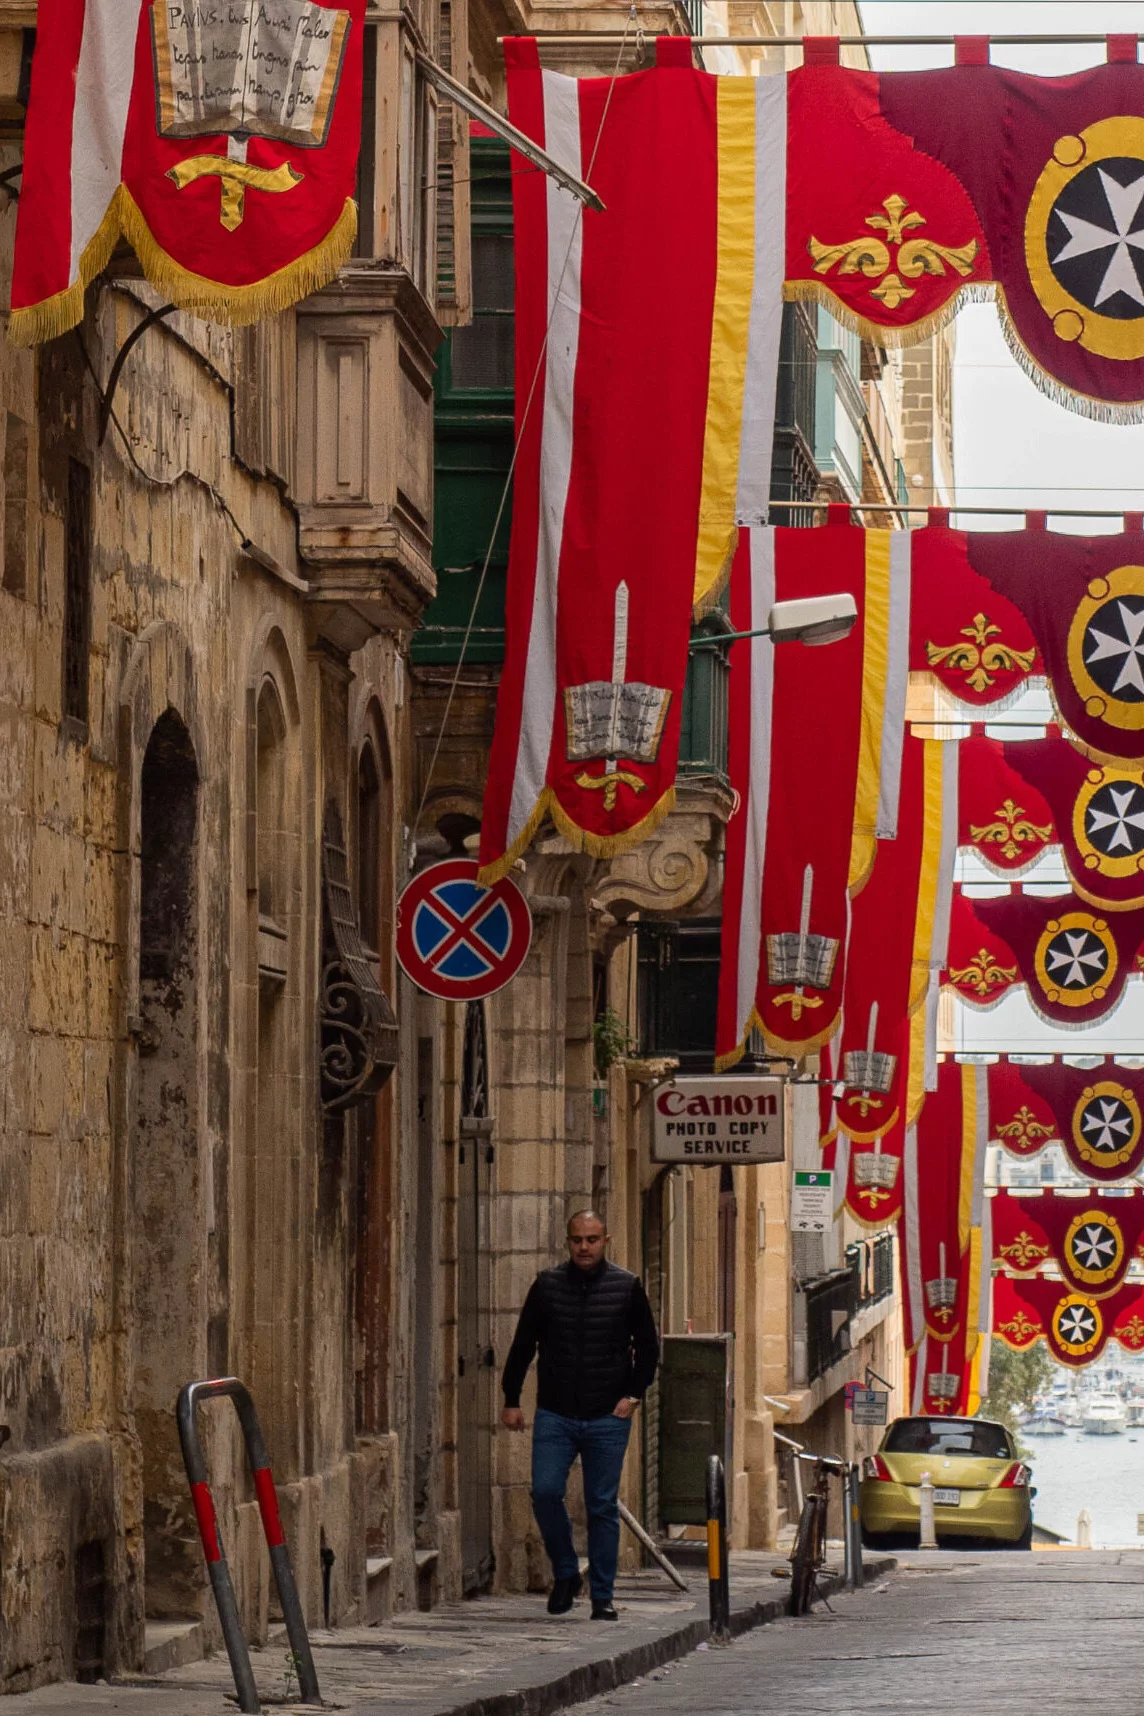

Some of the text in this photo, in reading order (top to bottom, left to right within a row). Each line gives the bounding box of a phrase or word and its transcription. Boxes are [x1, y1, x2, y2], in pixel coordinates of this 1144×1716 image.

[656, 1089, 778, 1117] Canon
[665, 1121, 769, 1136] PHOTO COPY
[683, 1140, 751, 1155] SERVICE
[809, 1175, 817, 1184] P
